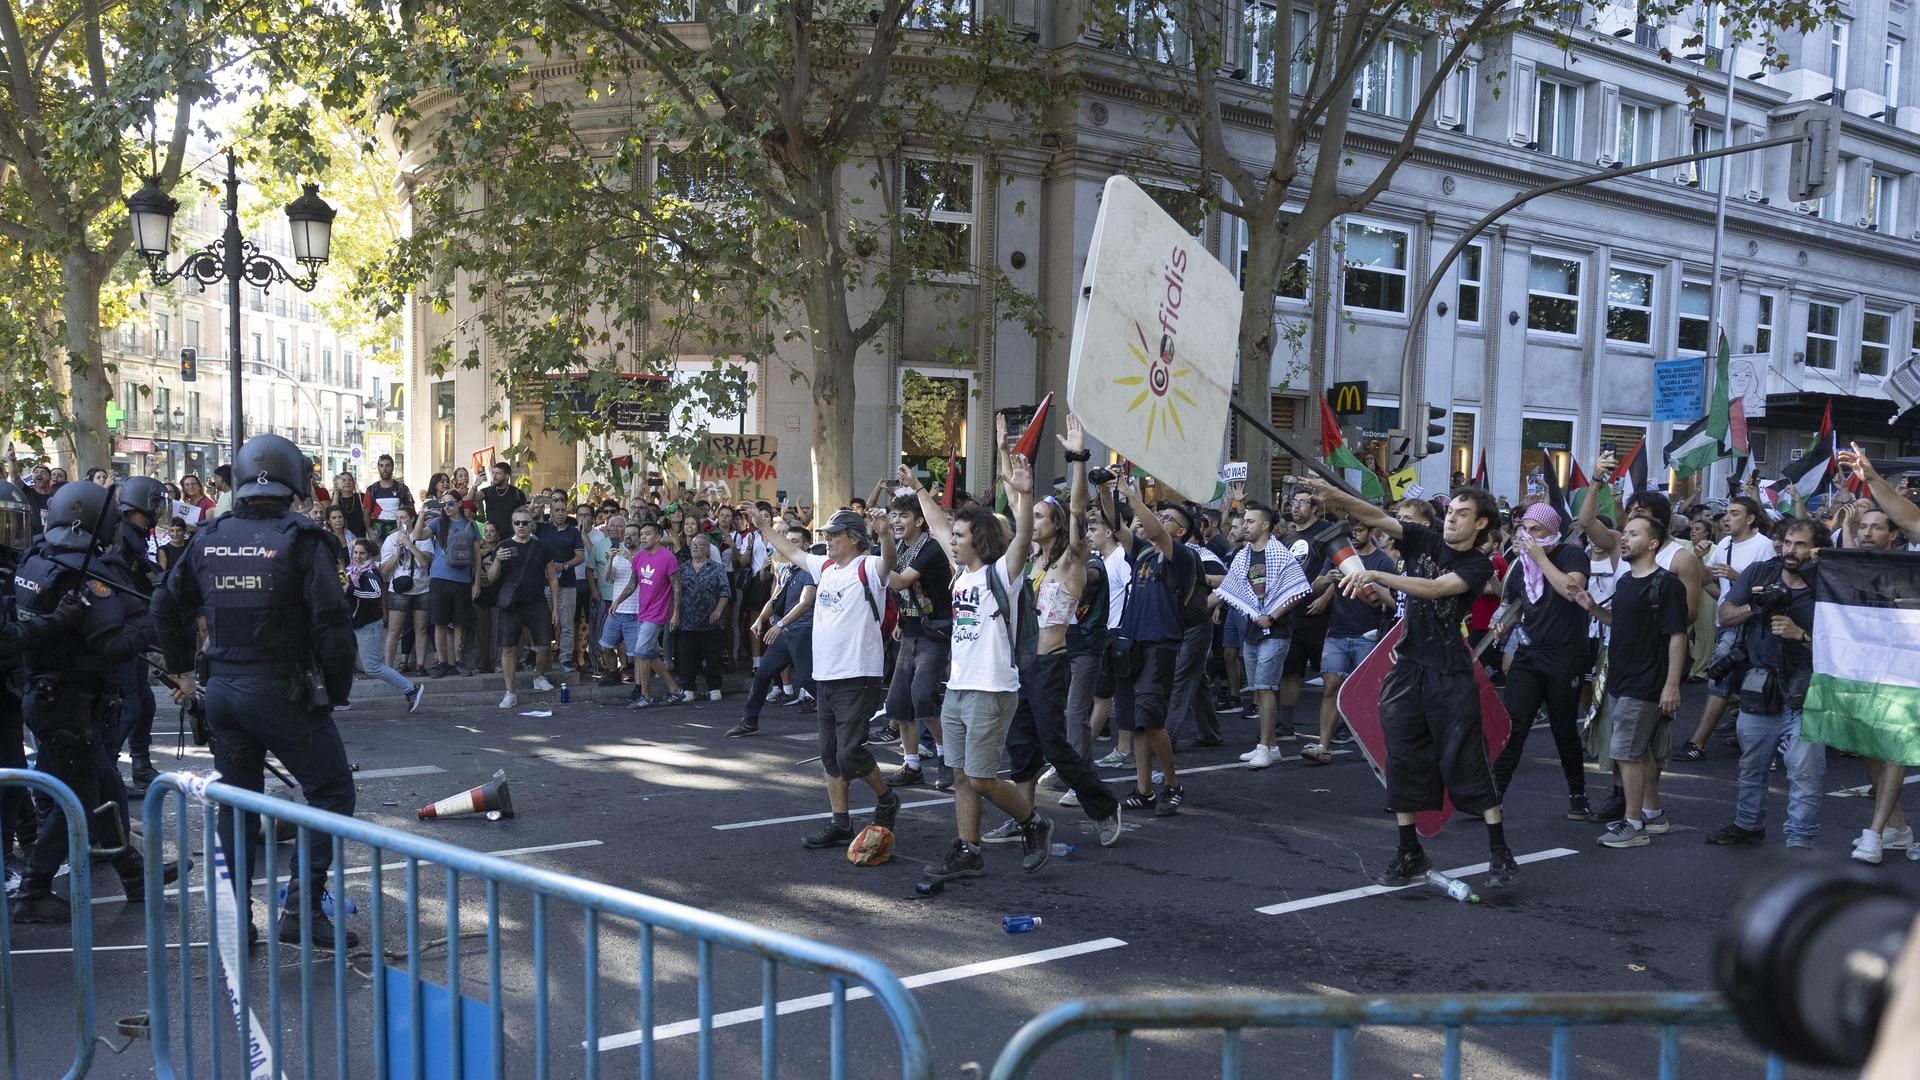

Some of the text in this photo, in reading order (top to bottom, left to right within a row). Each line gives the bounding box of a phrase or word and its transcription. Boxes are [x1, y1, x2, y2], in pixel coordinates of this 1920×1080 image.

[1149, 246, 1188, 397] Cfidis
[1231, 466, 1247, 477] WAR
[204, 546, 267, 557] POLICIA
